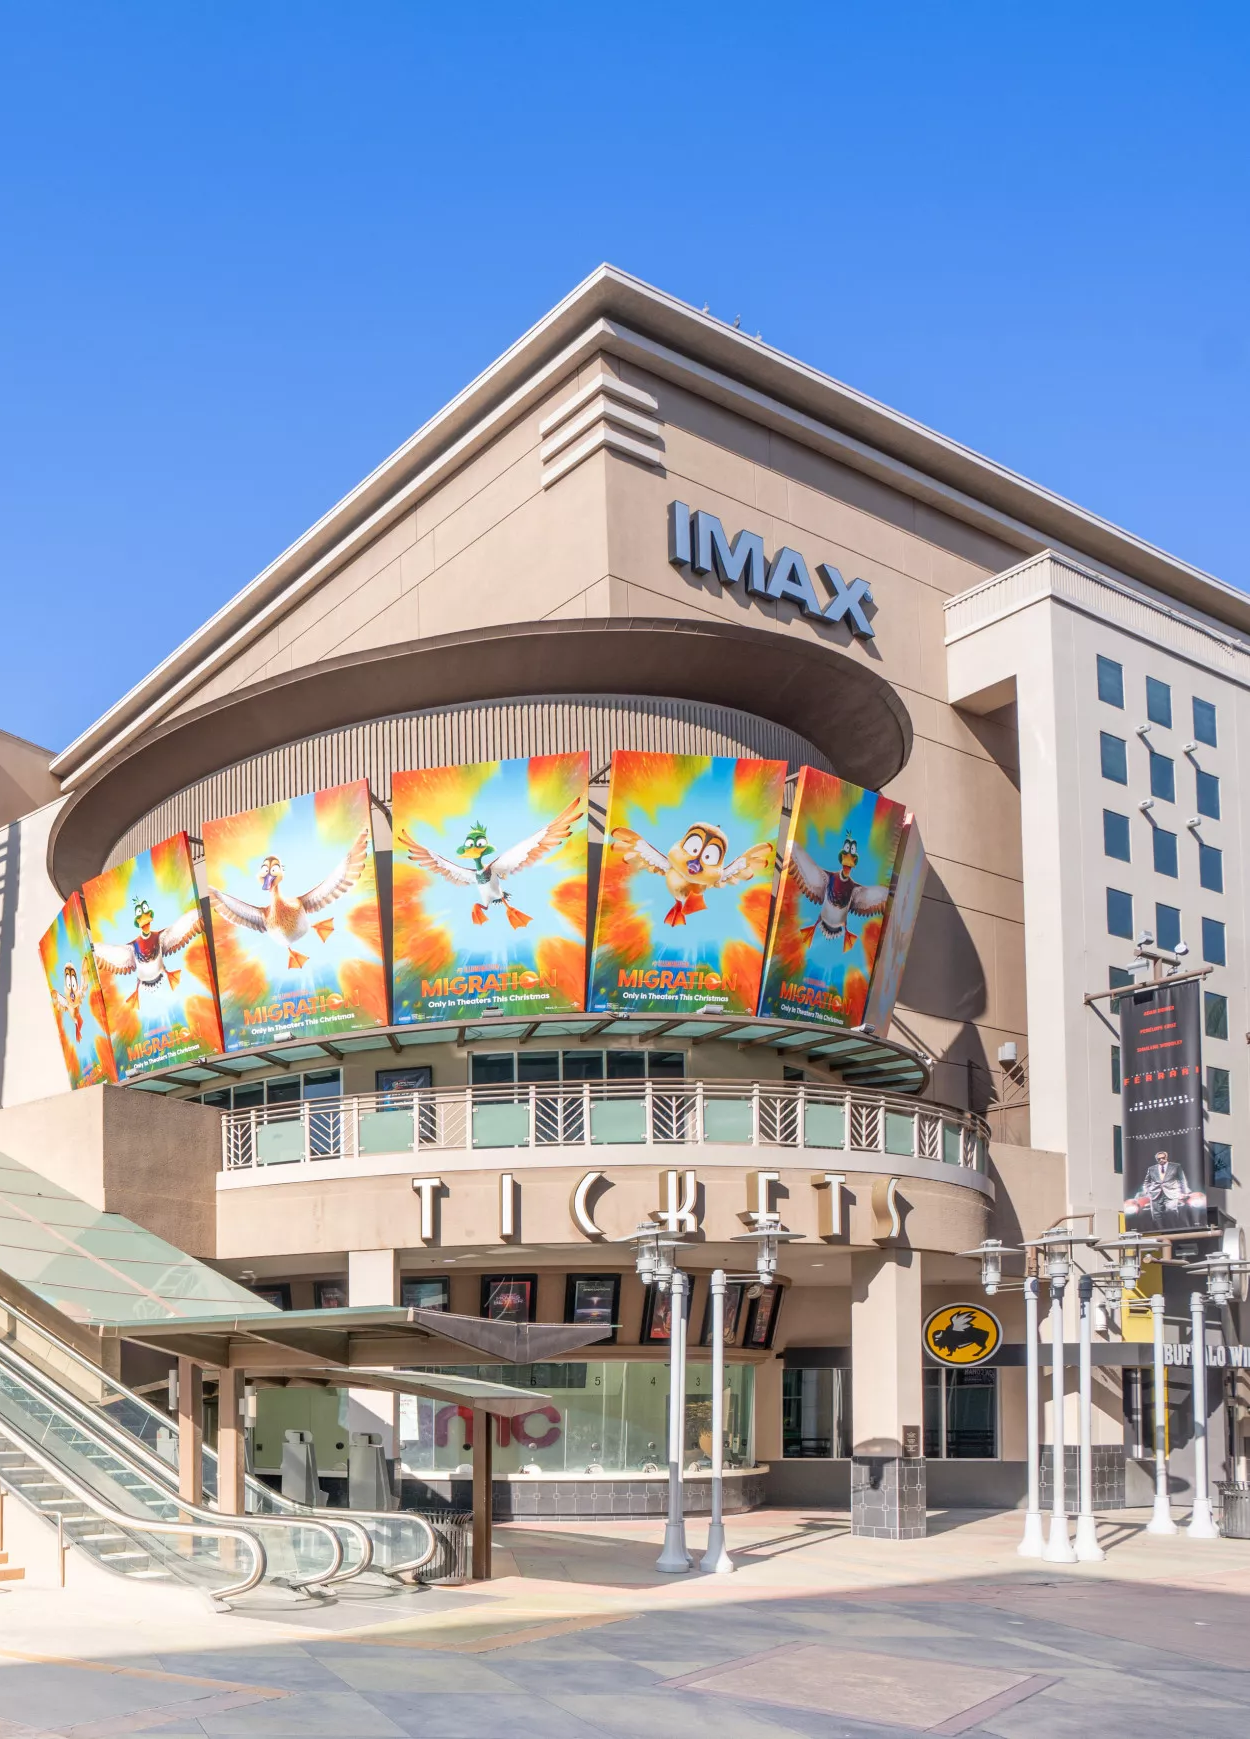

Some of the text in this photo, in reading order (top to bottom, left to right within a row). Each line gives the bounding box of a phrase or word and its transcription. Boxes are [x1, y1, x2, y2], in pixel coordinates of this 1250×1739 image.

[667, 500, 875, 641] IMAX
[421, 968, 558, 998] MIGRATION
[617, 968, 737, 992] MIGRATION
[243, 989, 360, 1026] MIGRATION
[428, 992, 550, 1009] Only In Theaters This Christmas
[623, 991, 729, 1002] Only In Theaters This Christmas
[779, 980, 852, 1016] MIGRATION
[251, 1012, 355, 1036] Only In Theaters This Christmas
[126, 1022, 203, 1062] MIGRATION
[1123, 1066, 1199, 1086] FERRARI
[411, 1169, 901, 1240] TICKETS
[1163, 1343, 1226, 1367] BUFLO
[530, 1377, 537, 1386] 6
[594, 1376, 601, 1386] 5
[650, 1376, 656, 1386] 4
[696, 1377, 701, 1387] 3
[728, 1378, 732, 1387] 2
